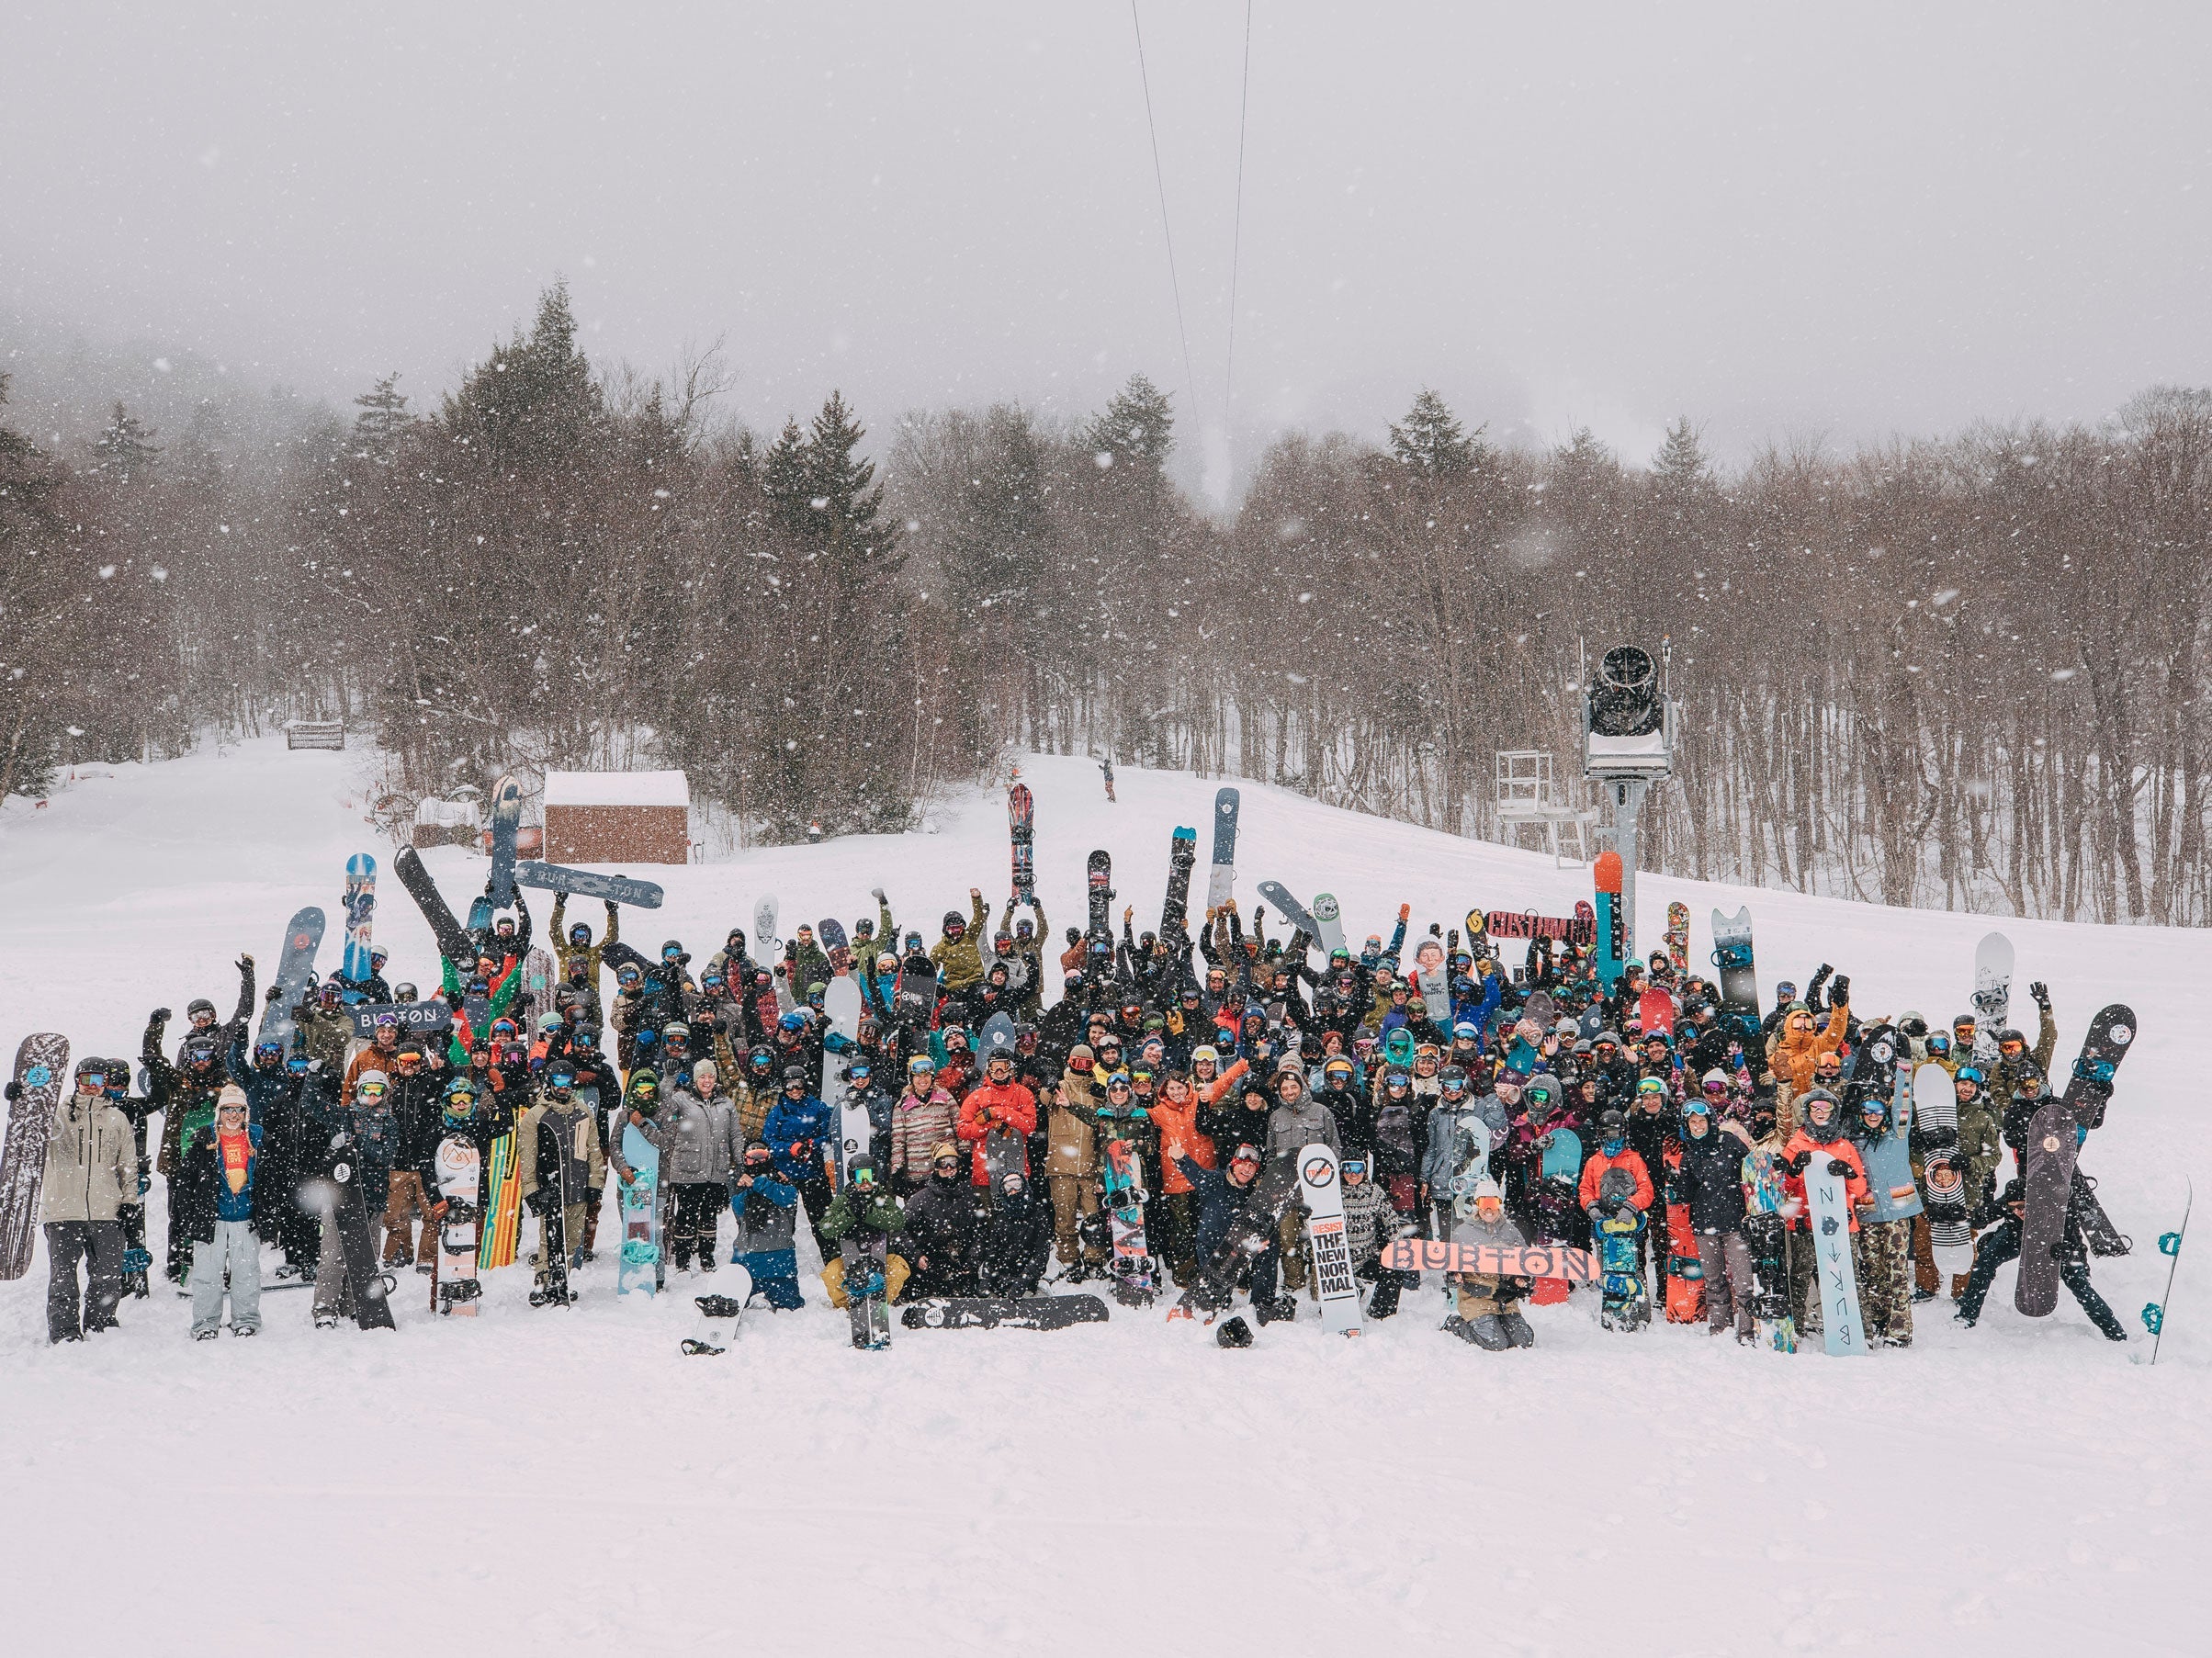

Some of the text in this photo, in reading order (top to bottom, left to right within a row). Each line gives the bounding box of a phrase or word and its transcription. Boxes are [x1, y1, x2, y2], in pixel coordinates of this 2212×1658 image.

[361, 1009, 437, 1028] BTON
[1312, 1222, 1343, 1235] RESIST
[1314, 1232, 1345, 1250] THE
[1316, 1247, 1346, 1264] NEW
[1392, 1239, 1590, 1280] BURTON
[1318, 1262, 1349, 1279] NOR
[1321, 1276, 1353, 1294] MAL
